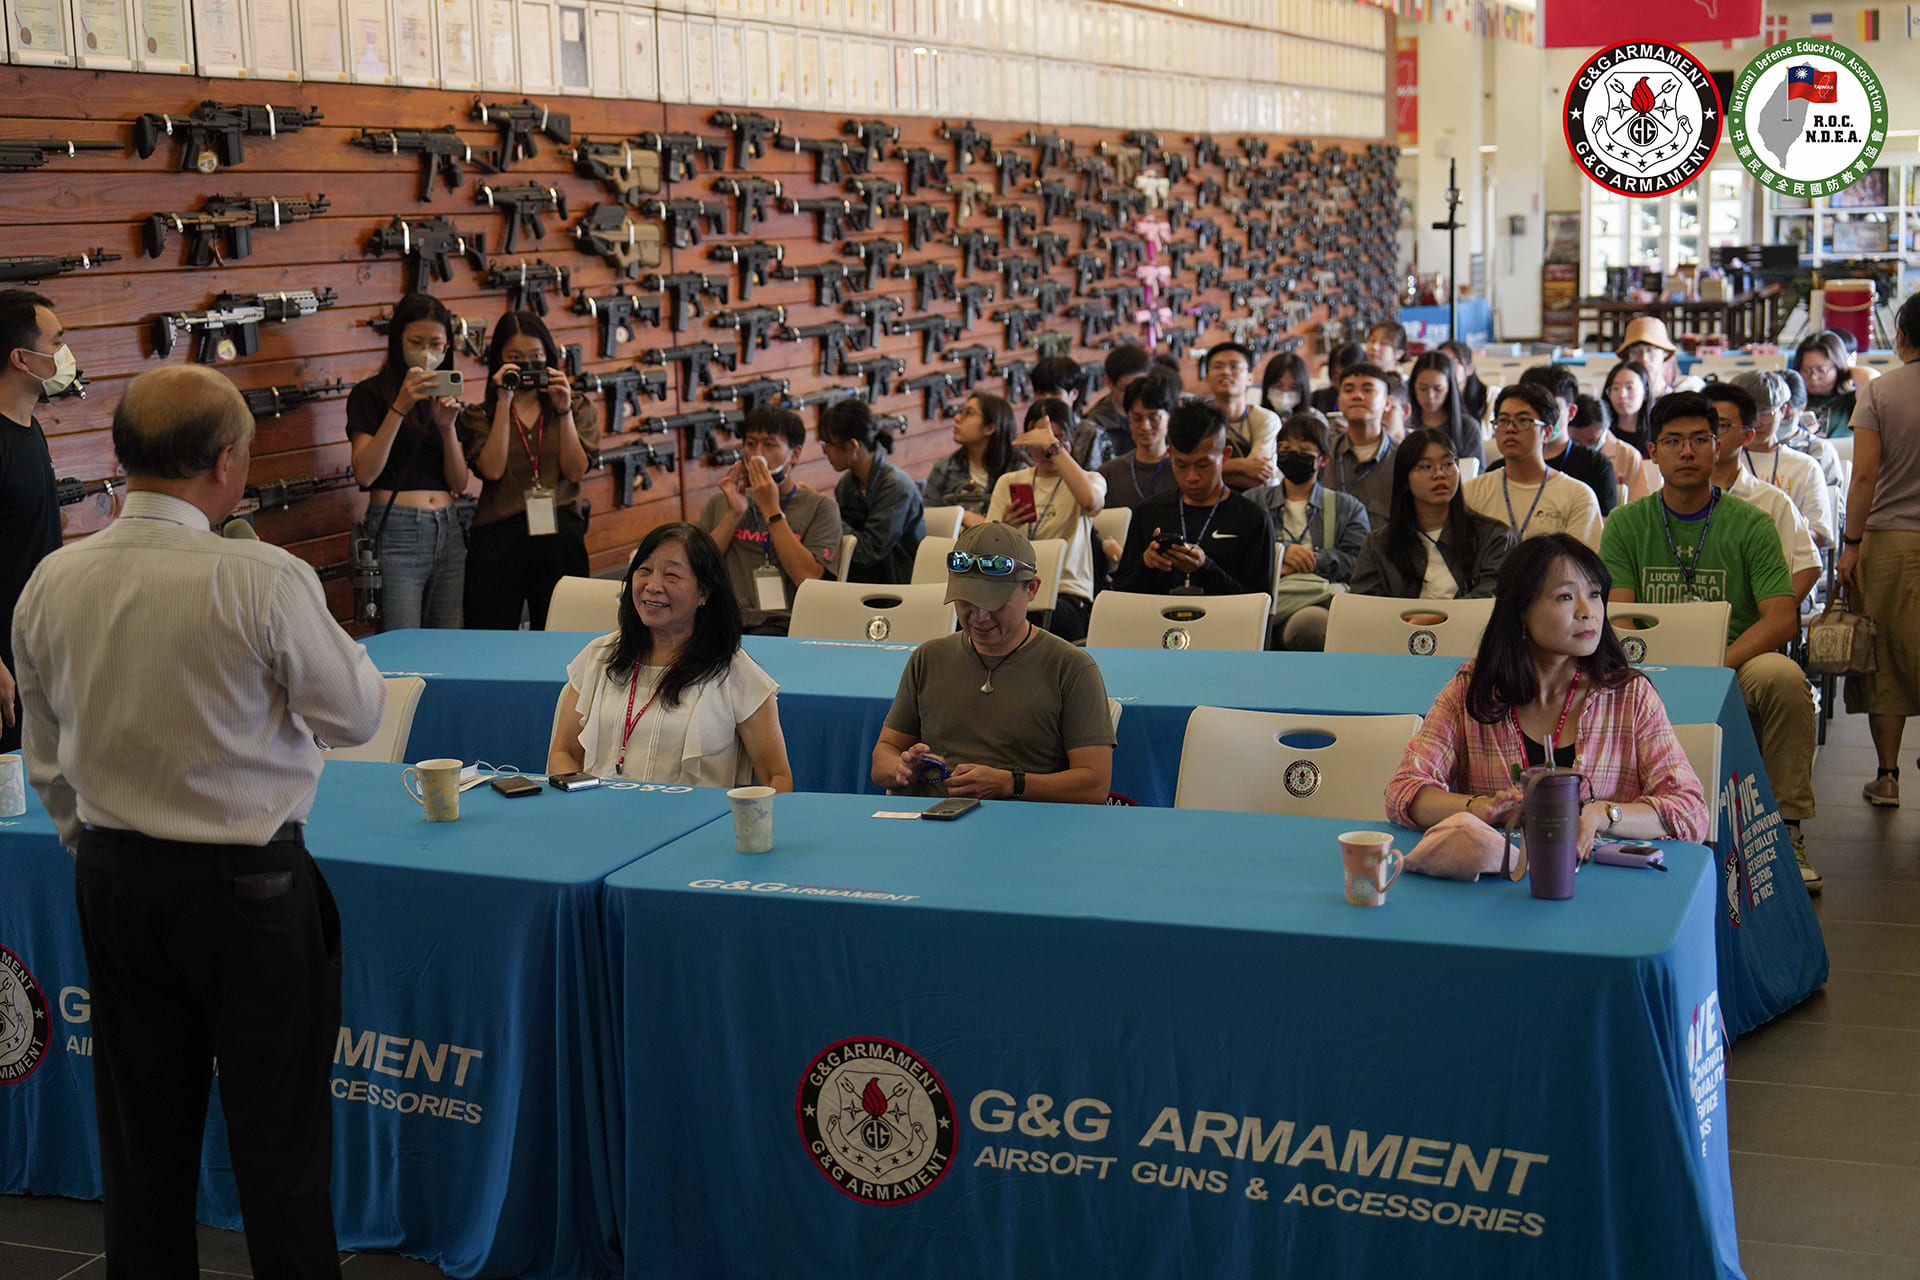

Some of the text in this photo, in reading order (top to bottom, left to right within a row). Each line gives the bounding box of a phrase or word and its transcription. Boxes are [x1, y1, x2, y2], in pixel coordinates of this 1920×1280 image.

[1650, 573, 1680, 582] LUCKY
[1709, 576, 1717, 584] A
[2, 950, 36, 992] MENT
[332, 1026, 484, 1087] MENT
[809, 1042, 942, 1096] G&G ARMAMENT
[330, 1077, 484, 1124] CESSORIES
[811, 1140, 948, 1200] G&G ARMAMENT
[968, 1089, 1549, 1196] G&G ARMAMENT
[973, 1145, 1546, 1237] AIRSOFT GUNS & ACCESSORIES
